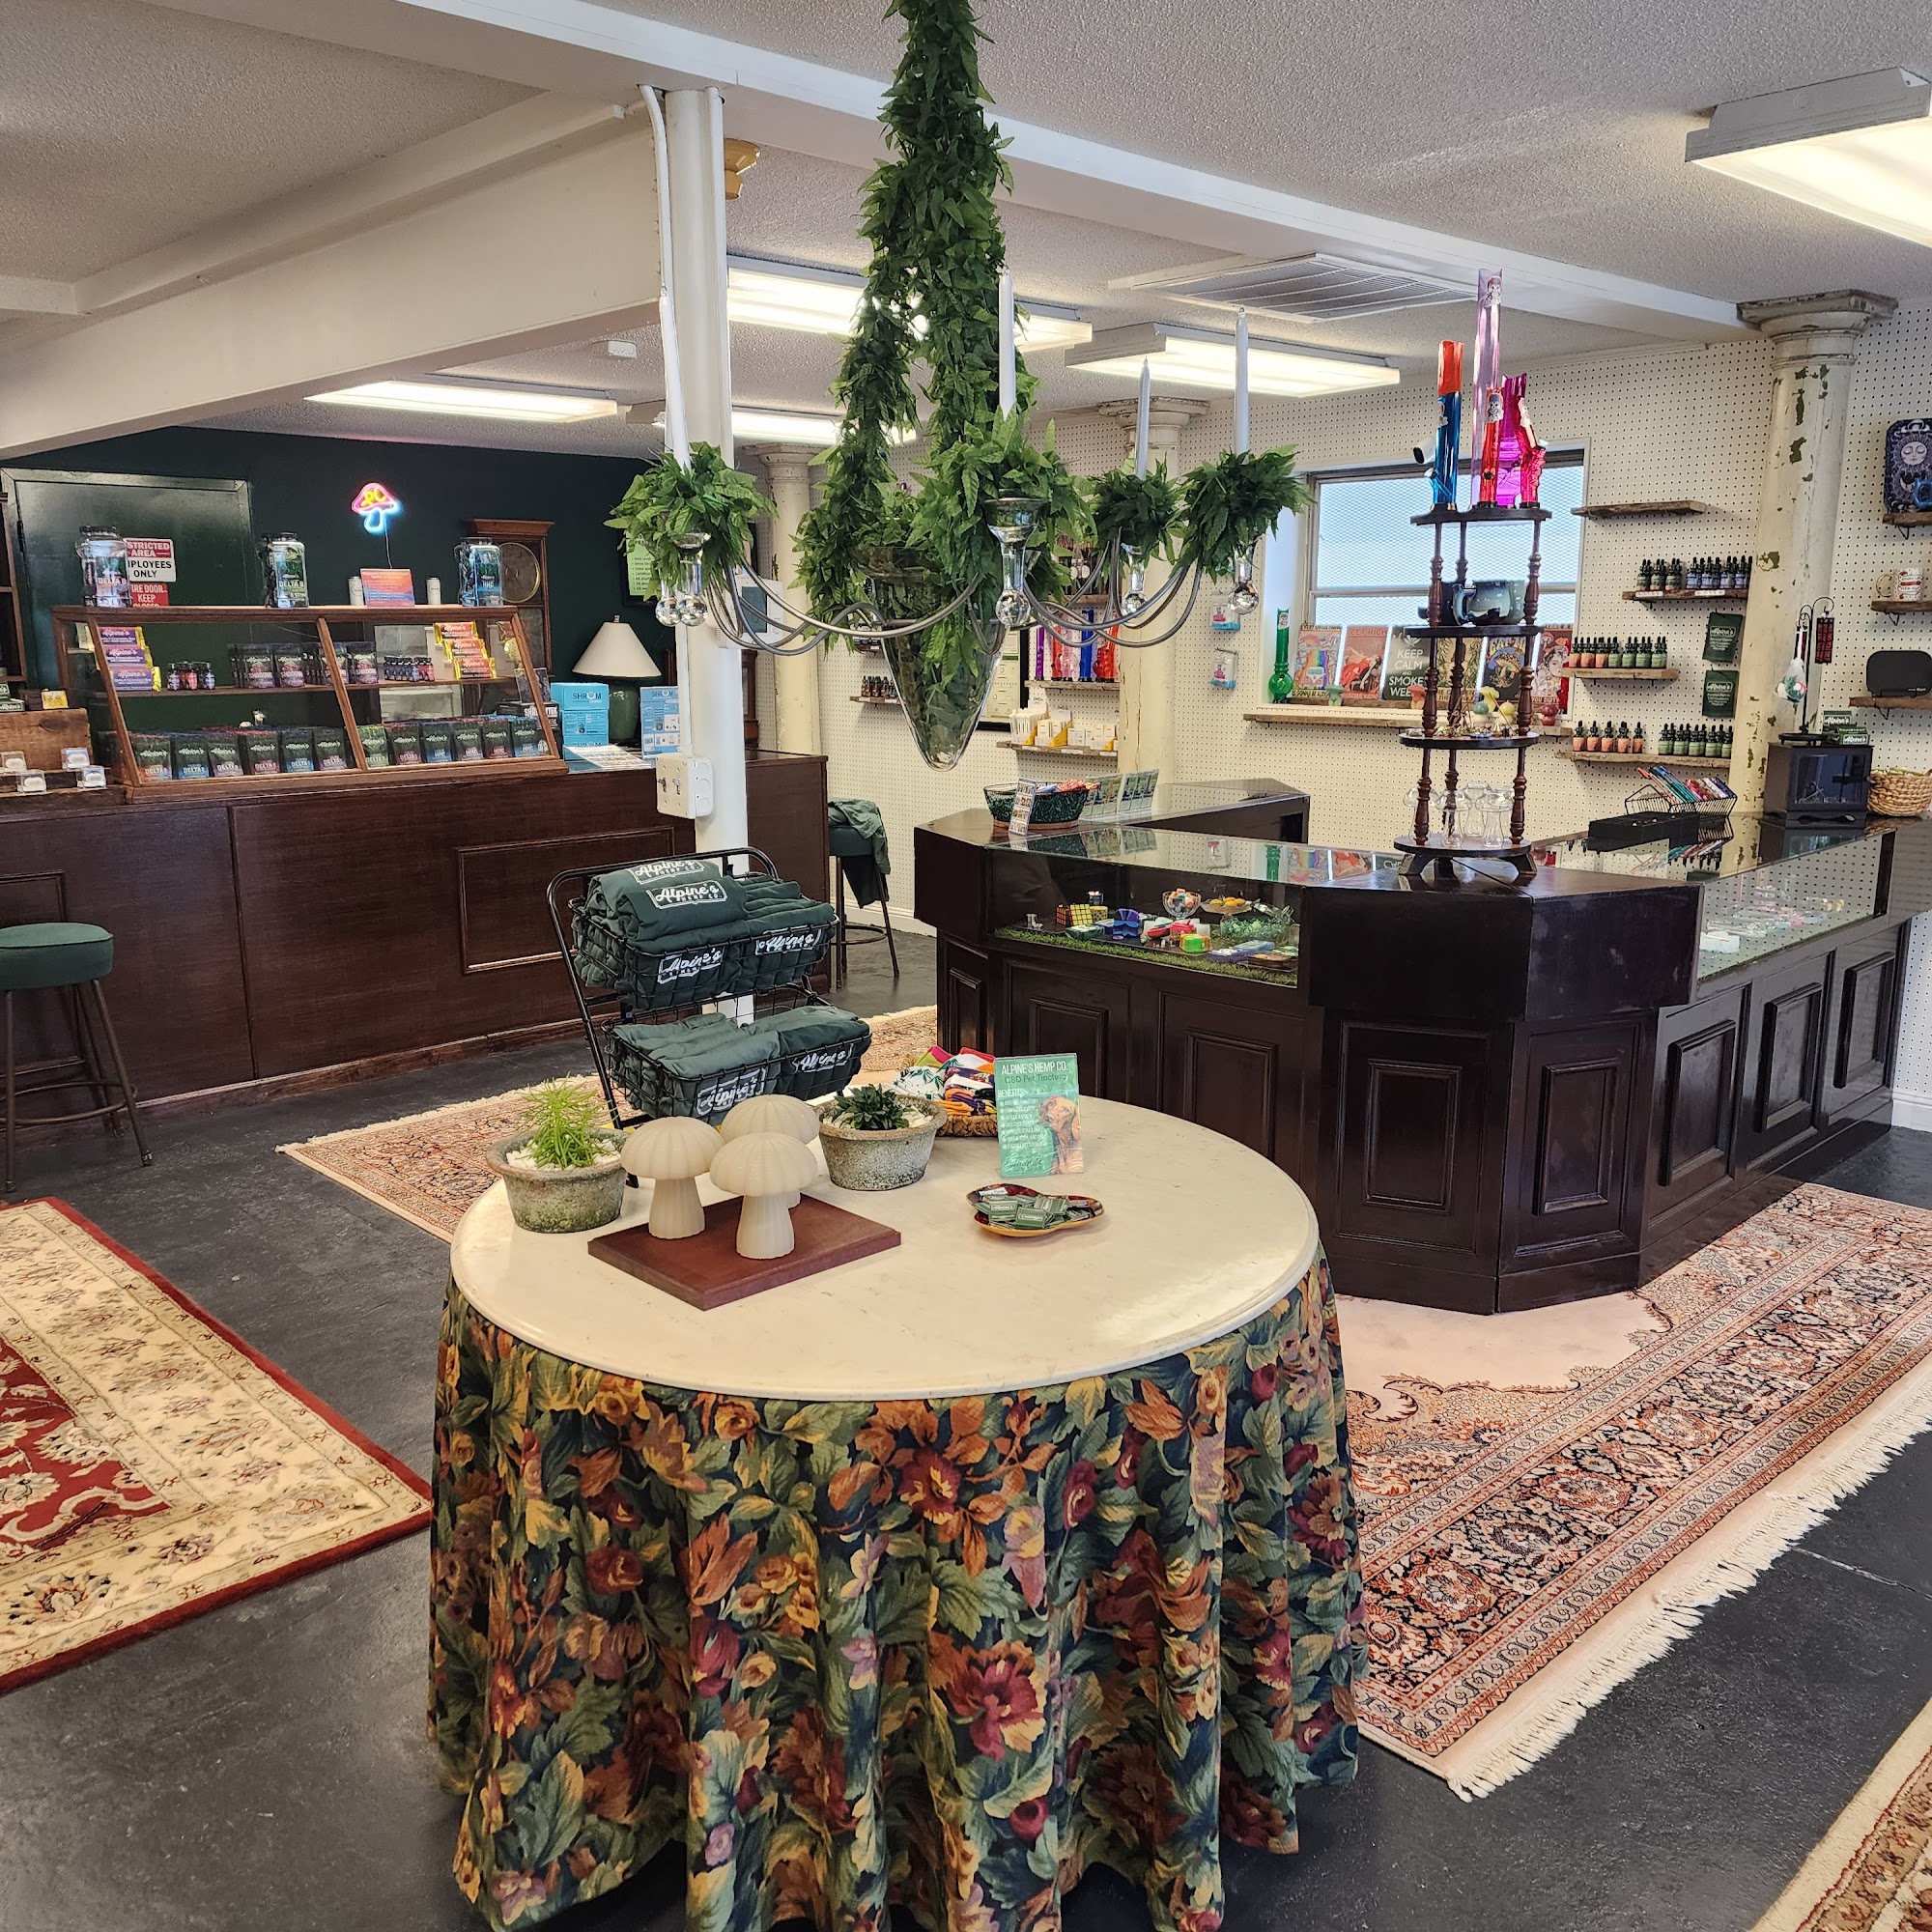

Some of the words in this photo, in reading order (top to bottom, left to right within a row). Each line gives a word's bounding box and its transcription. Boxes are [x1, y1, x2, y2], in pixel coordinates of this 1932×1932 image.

[128, 560, 172, 569] PLOYEES
[131, 583, 144, 593] IRE
[144, 583, 163, 592] DOOR
[137, 594, 156, 603] KEEP
[1397, 649, 1423, 658] KEEP
[1394, 661, 1422, 669] CALM
[1389, 676, 1424, 686] SMOKE
[1390, 687, 1411, 696] WEE
[635, 860, 696, 877] Alpine's
[655, 883, 719, 902] Alpine's
[1002, 1063, 1034, 1075] ALPINE'S
[1035, 1062, 1055, 1072] HEMP
[1057, 1060, 1068, 1071] CO.
